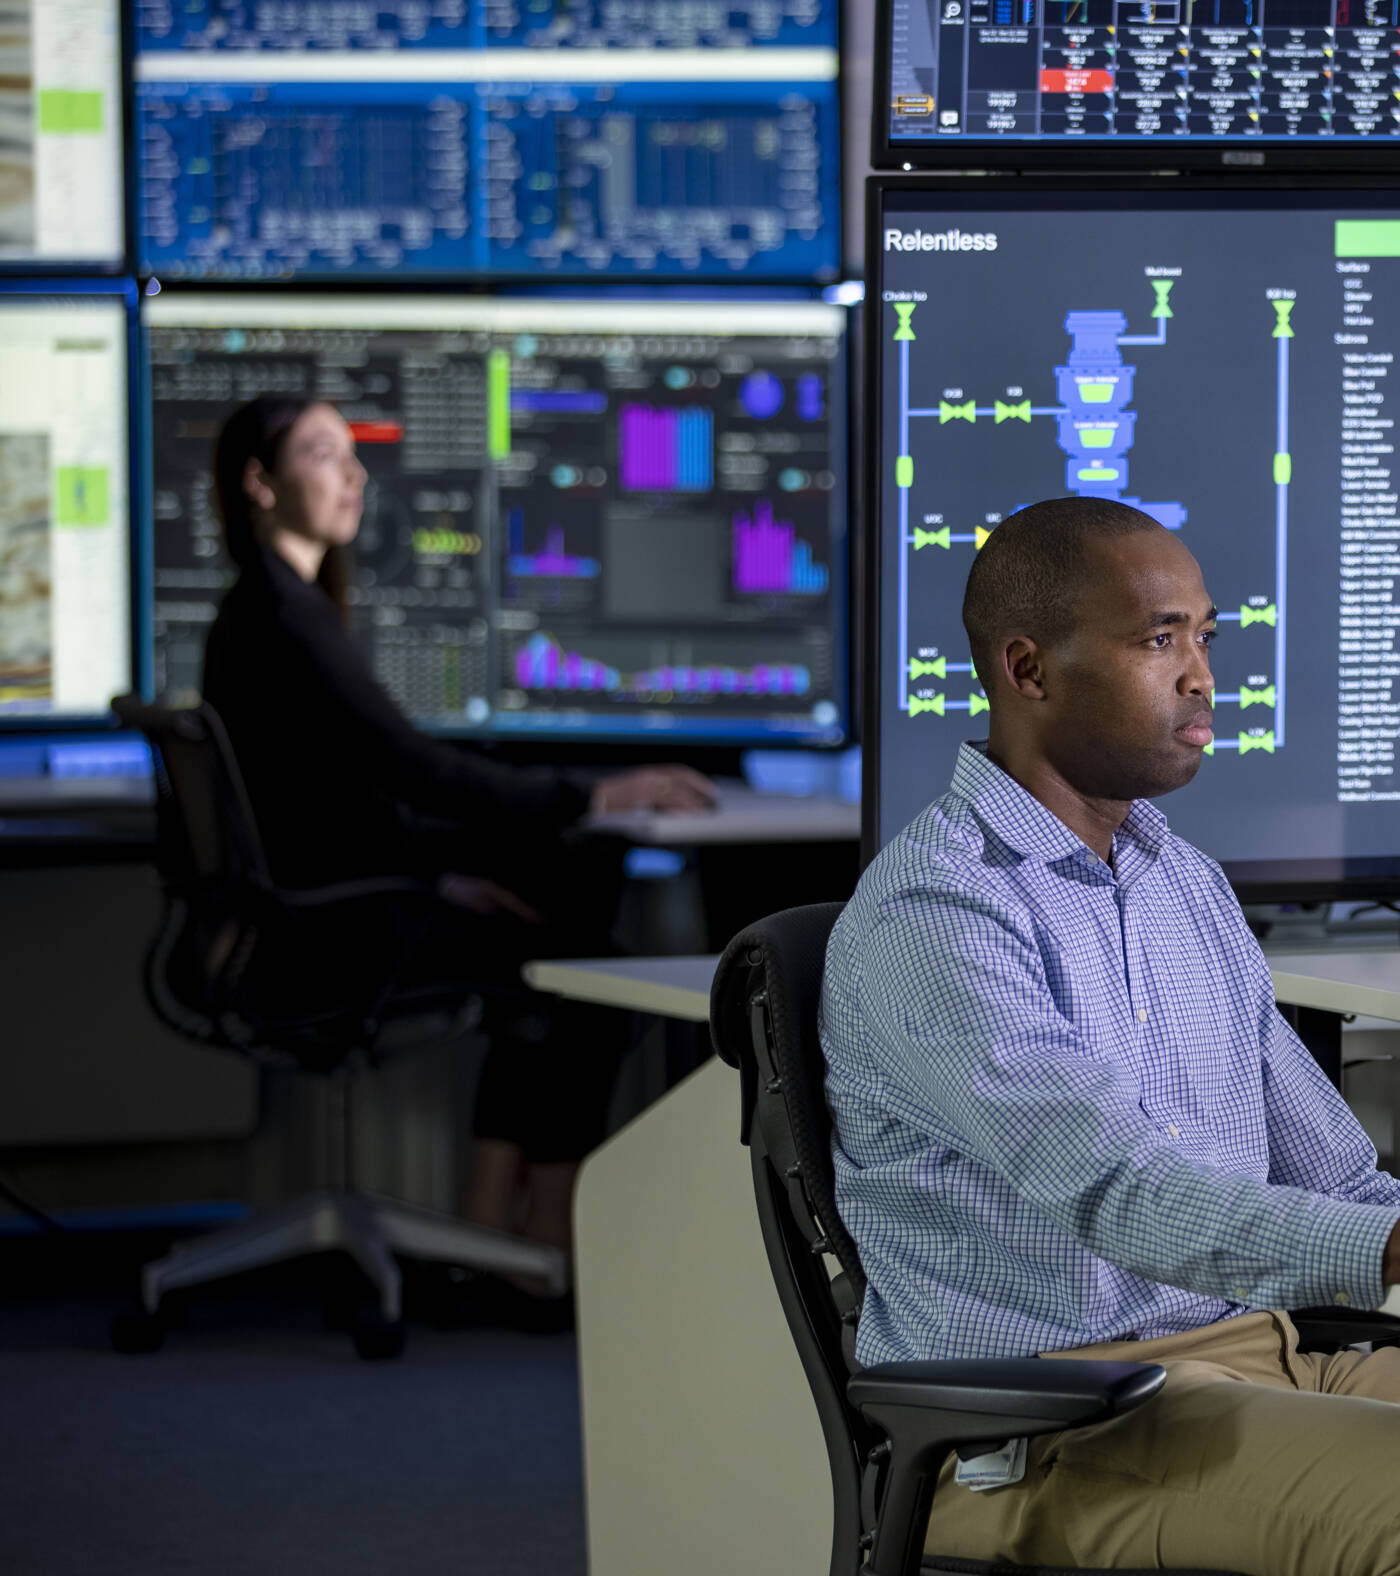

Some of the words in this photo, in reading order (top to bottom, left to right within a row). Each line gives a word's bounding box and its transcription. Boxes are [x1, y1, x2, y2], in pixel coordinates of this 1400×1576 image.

[884, 229, 998, 252] Relentless
[1335, 261, 1370, 273] Surface
[882, 290, 912, 302] Choke
[913, 290, 928, 302] Iso
